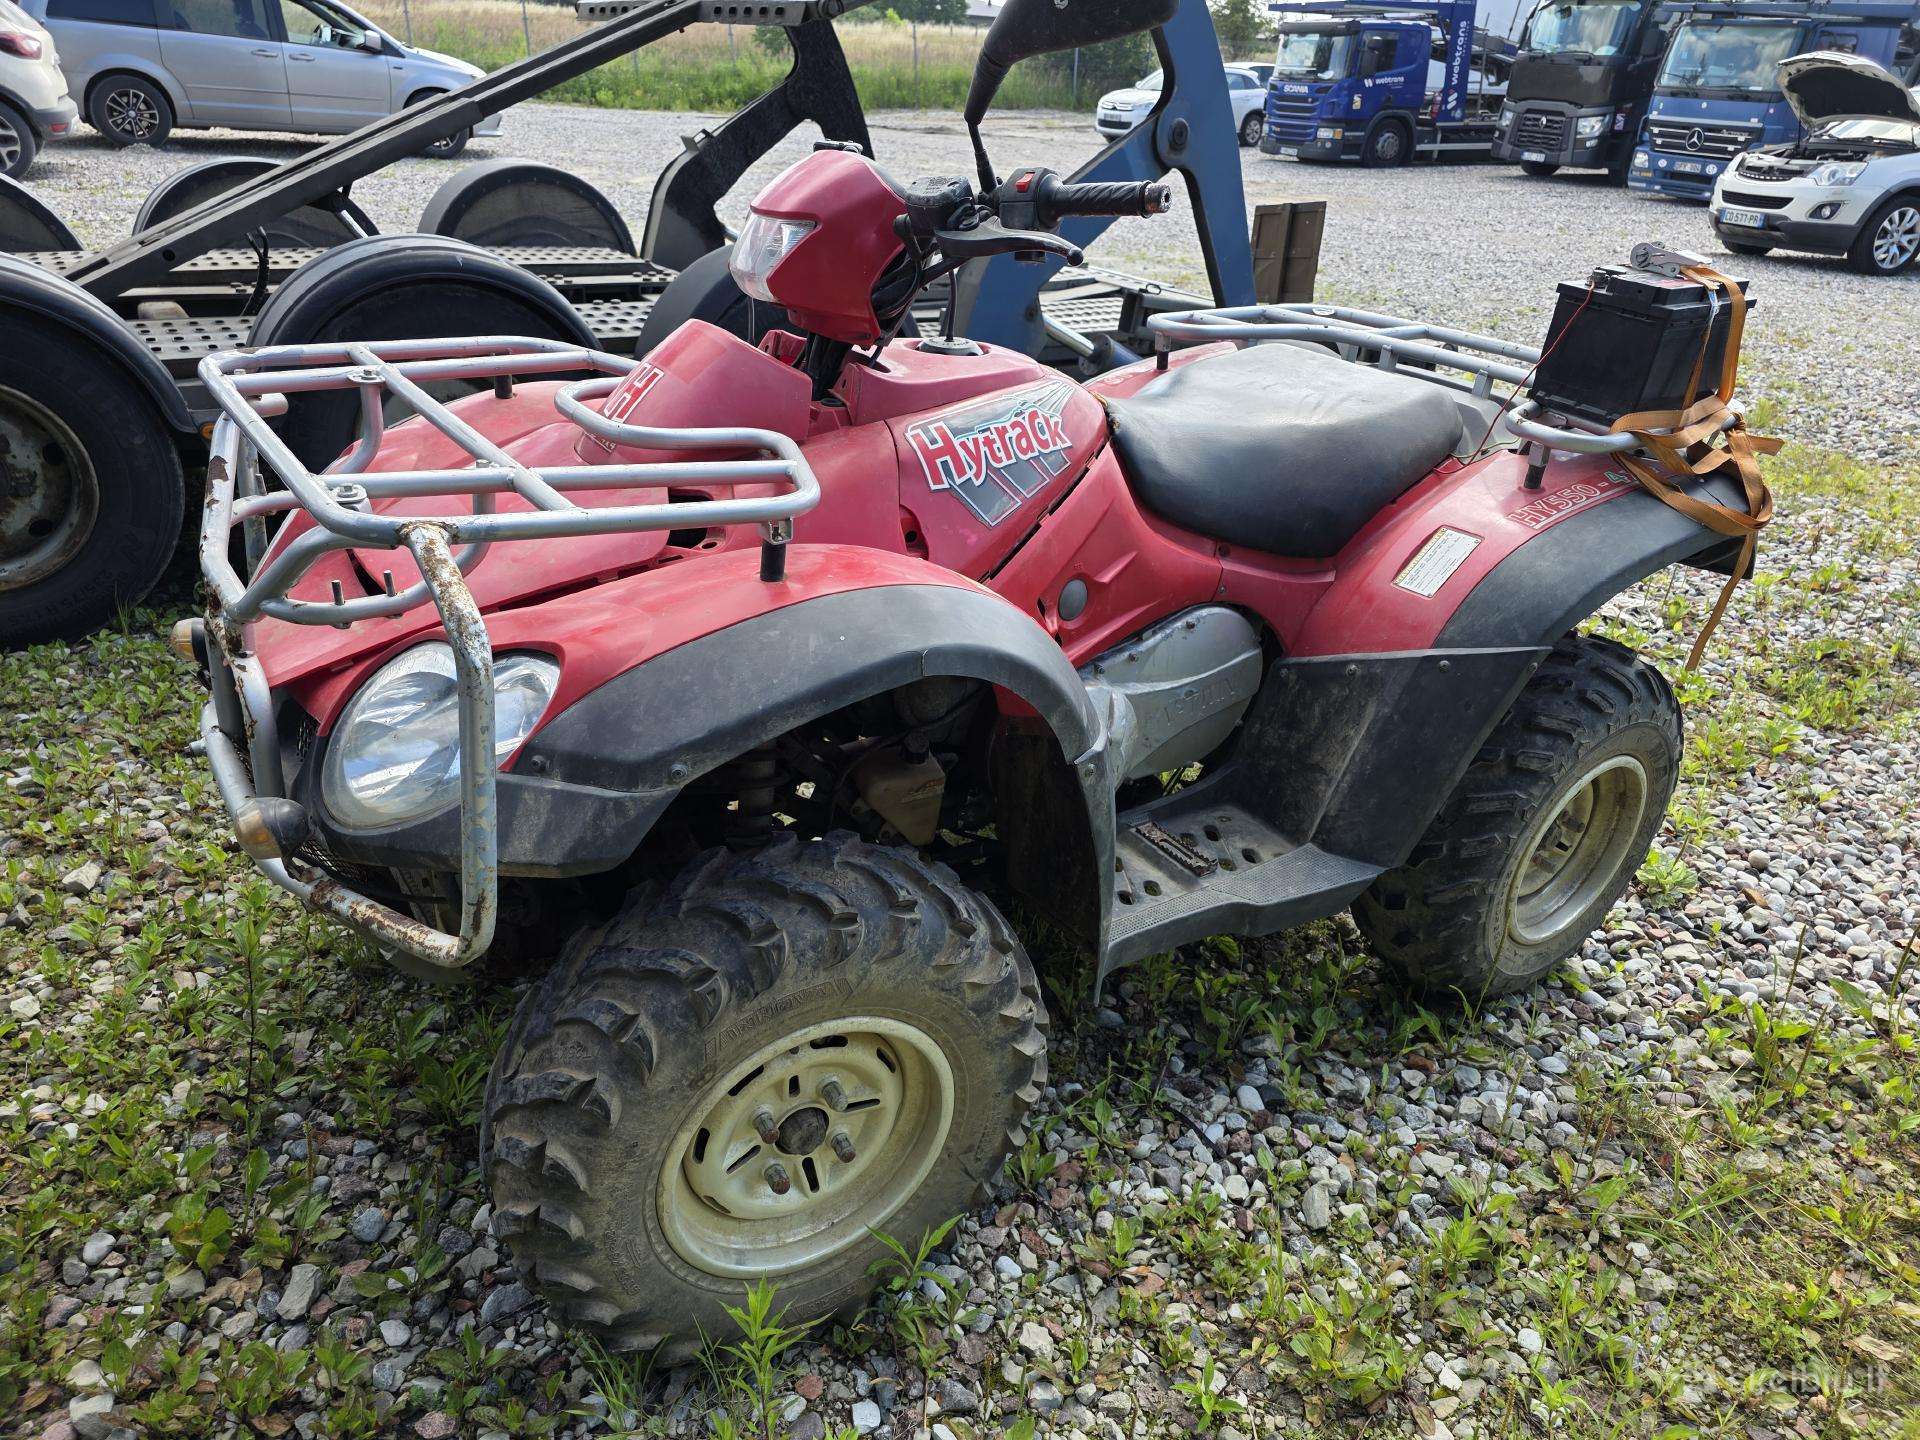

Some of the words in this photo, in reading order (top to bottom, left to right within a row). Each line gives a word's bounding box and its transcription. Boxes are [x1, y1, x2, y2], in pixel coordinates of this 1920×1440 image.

[1451, 20, 1467, 86] webtrans
[1375, 76, 1405, 85] webtrans
[1283, 84, 1309, 94] SCANIA
